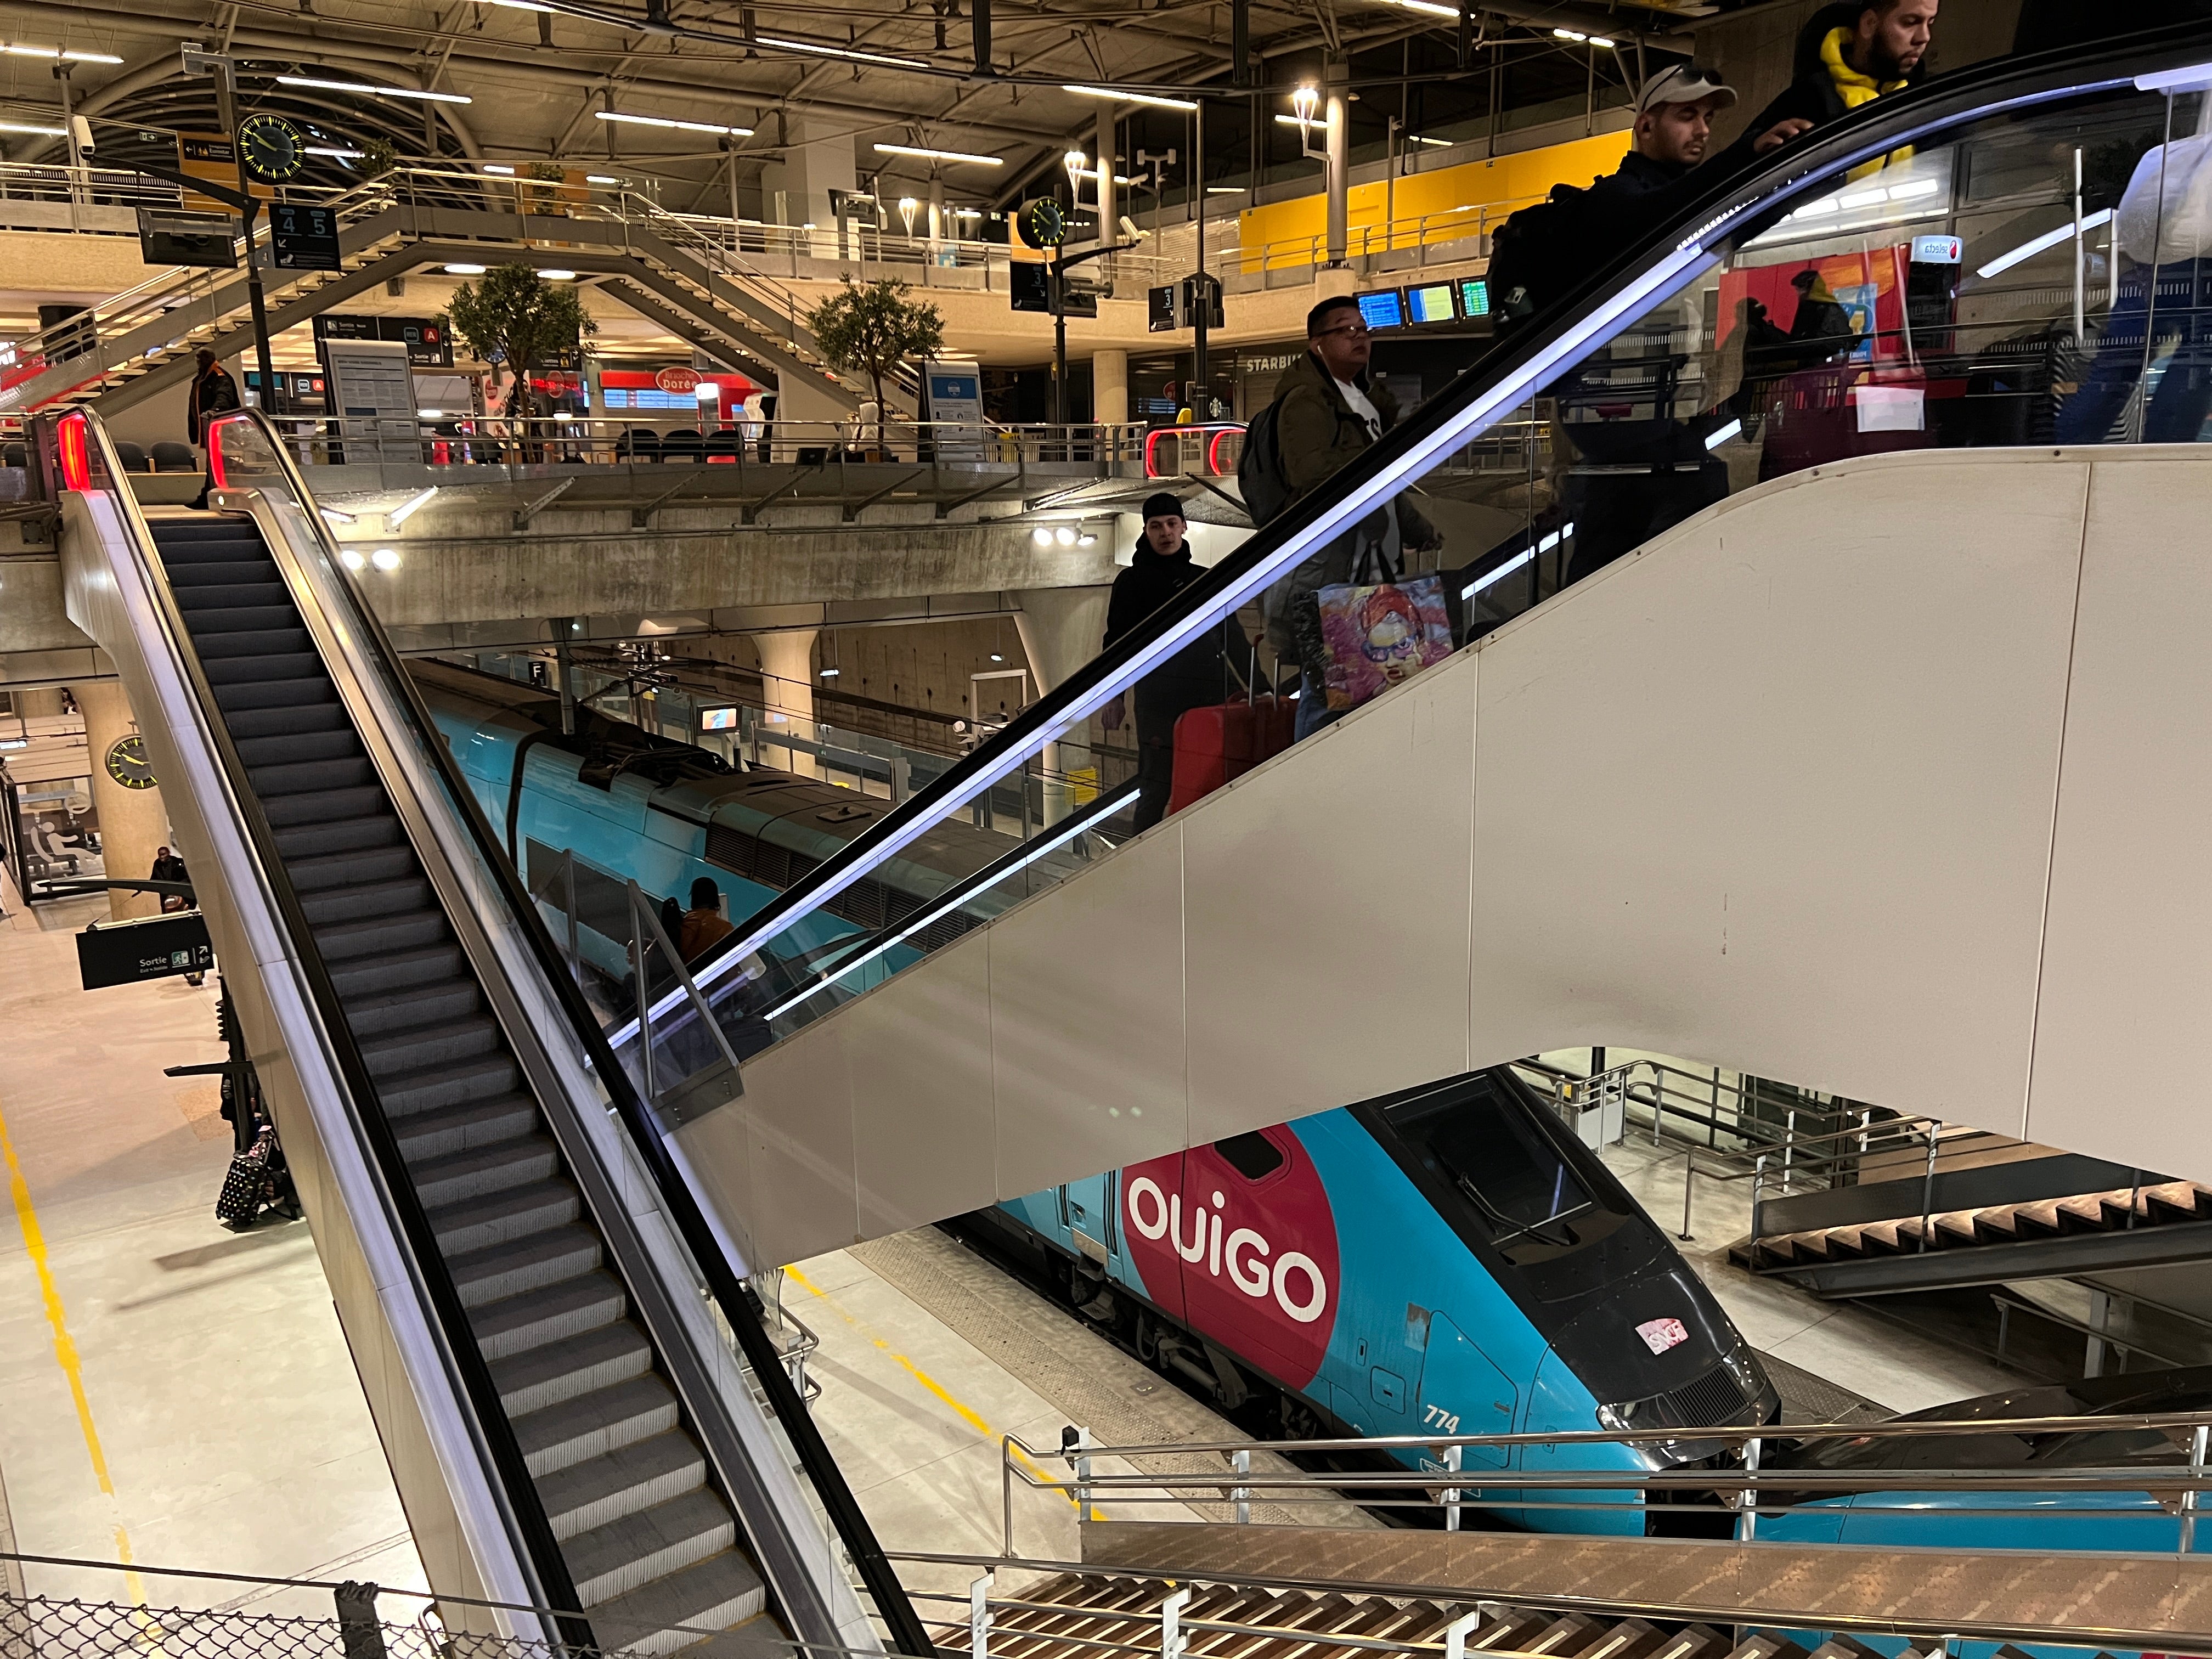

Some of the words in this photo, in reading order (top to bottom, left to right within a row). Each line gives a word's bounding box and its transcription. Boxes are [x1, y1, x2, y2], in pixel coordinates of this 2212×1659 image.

[283, 217, 295, 233] 4
[314, 218, 326, 235] 5
[1034, 272, 1041, 285] 3
[1165, 294, 1171, 306] 3
[427, 331, 436, 341] A
[664, 371, 695, 380] Brioche
[663, 378, 697, 390] Dorée
[139, 956, 167, 967] Sortie
[1424, 1404, 1460, 1434] 774
